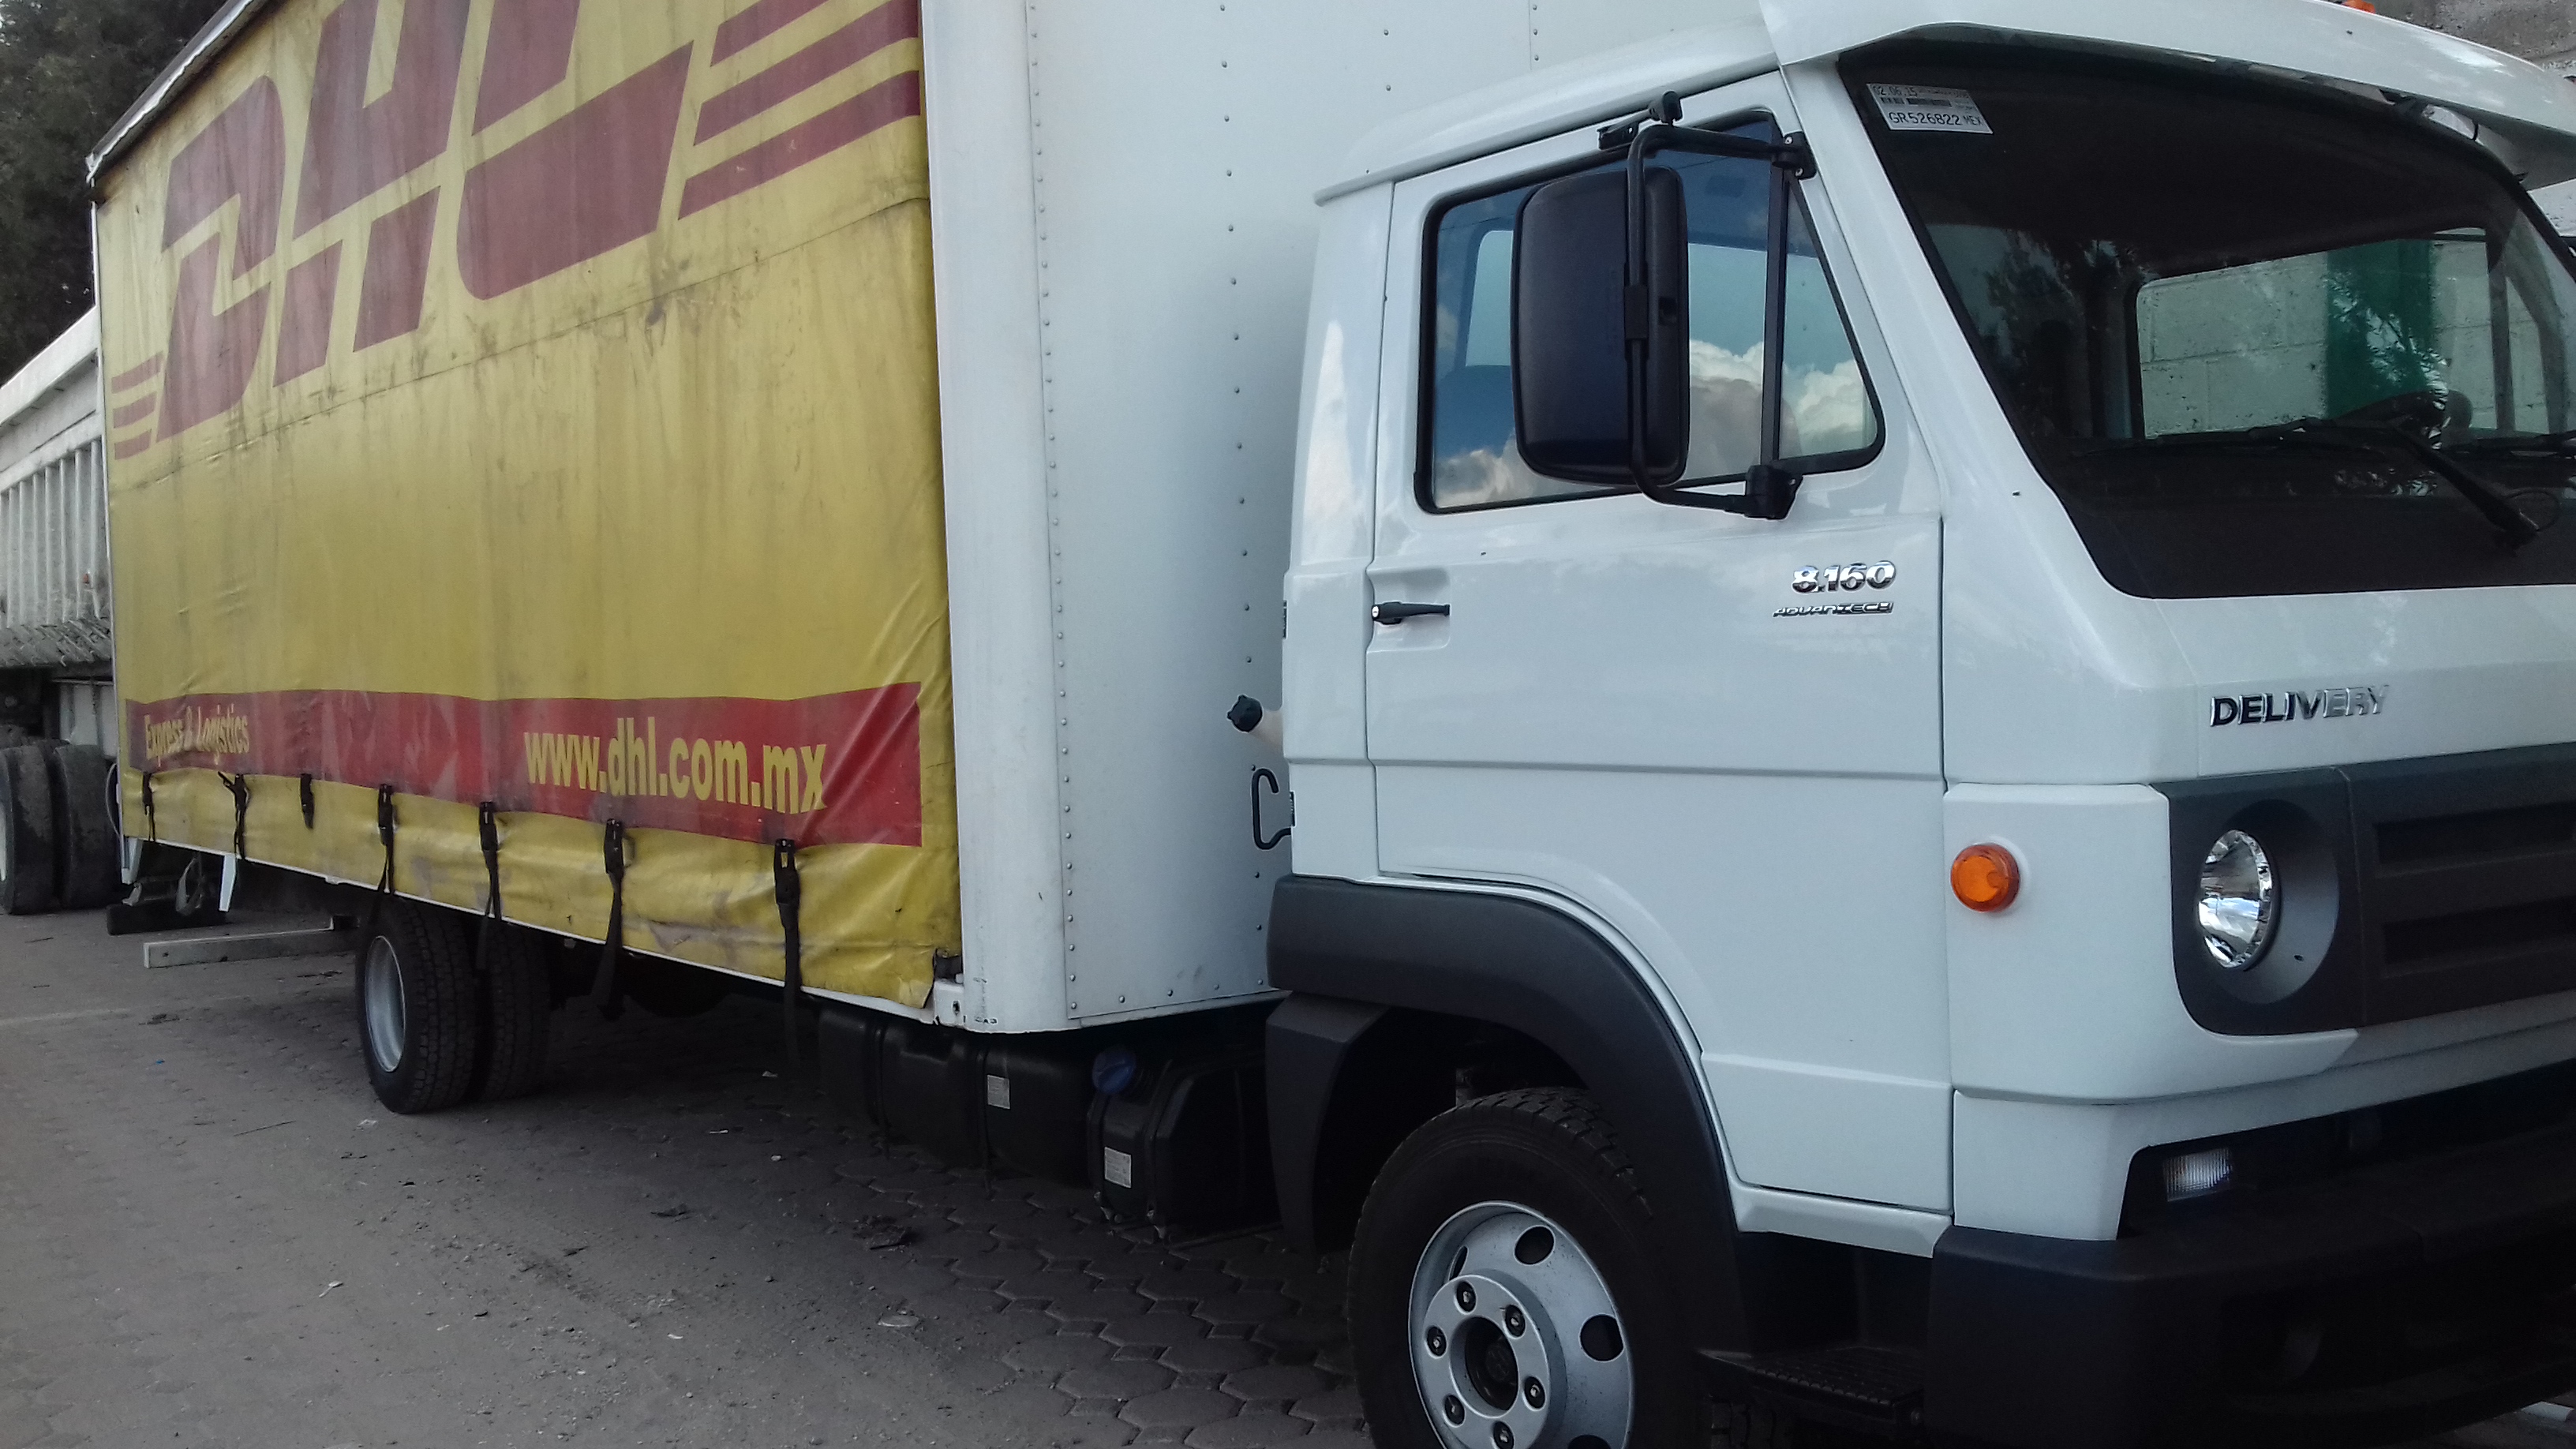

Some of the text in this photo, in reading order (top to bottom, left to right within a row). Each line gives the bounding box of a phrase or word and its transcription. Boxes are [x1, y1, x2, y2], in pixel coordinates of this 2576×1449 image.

[1889, 111, 1963, 126] GR526822
[157, 0, 694, 441] DHL
[1791, 560, 1897, 593] 8.160
[2210, 685, 2389, 727] DELIVERY
[144, 713, 184, 768] Express
[194, 702, 250, 766] Logistics
[523, 716, 827, 814] www.dhl.com.mx
